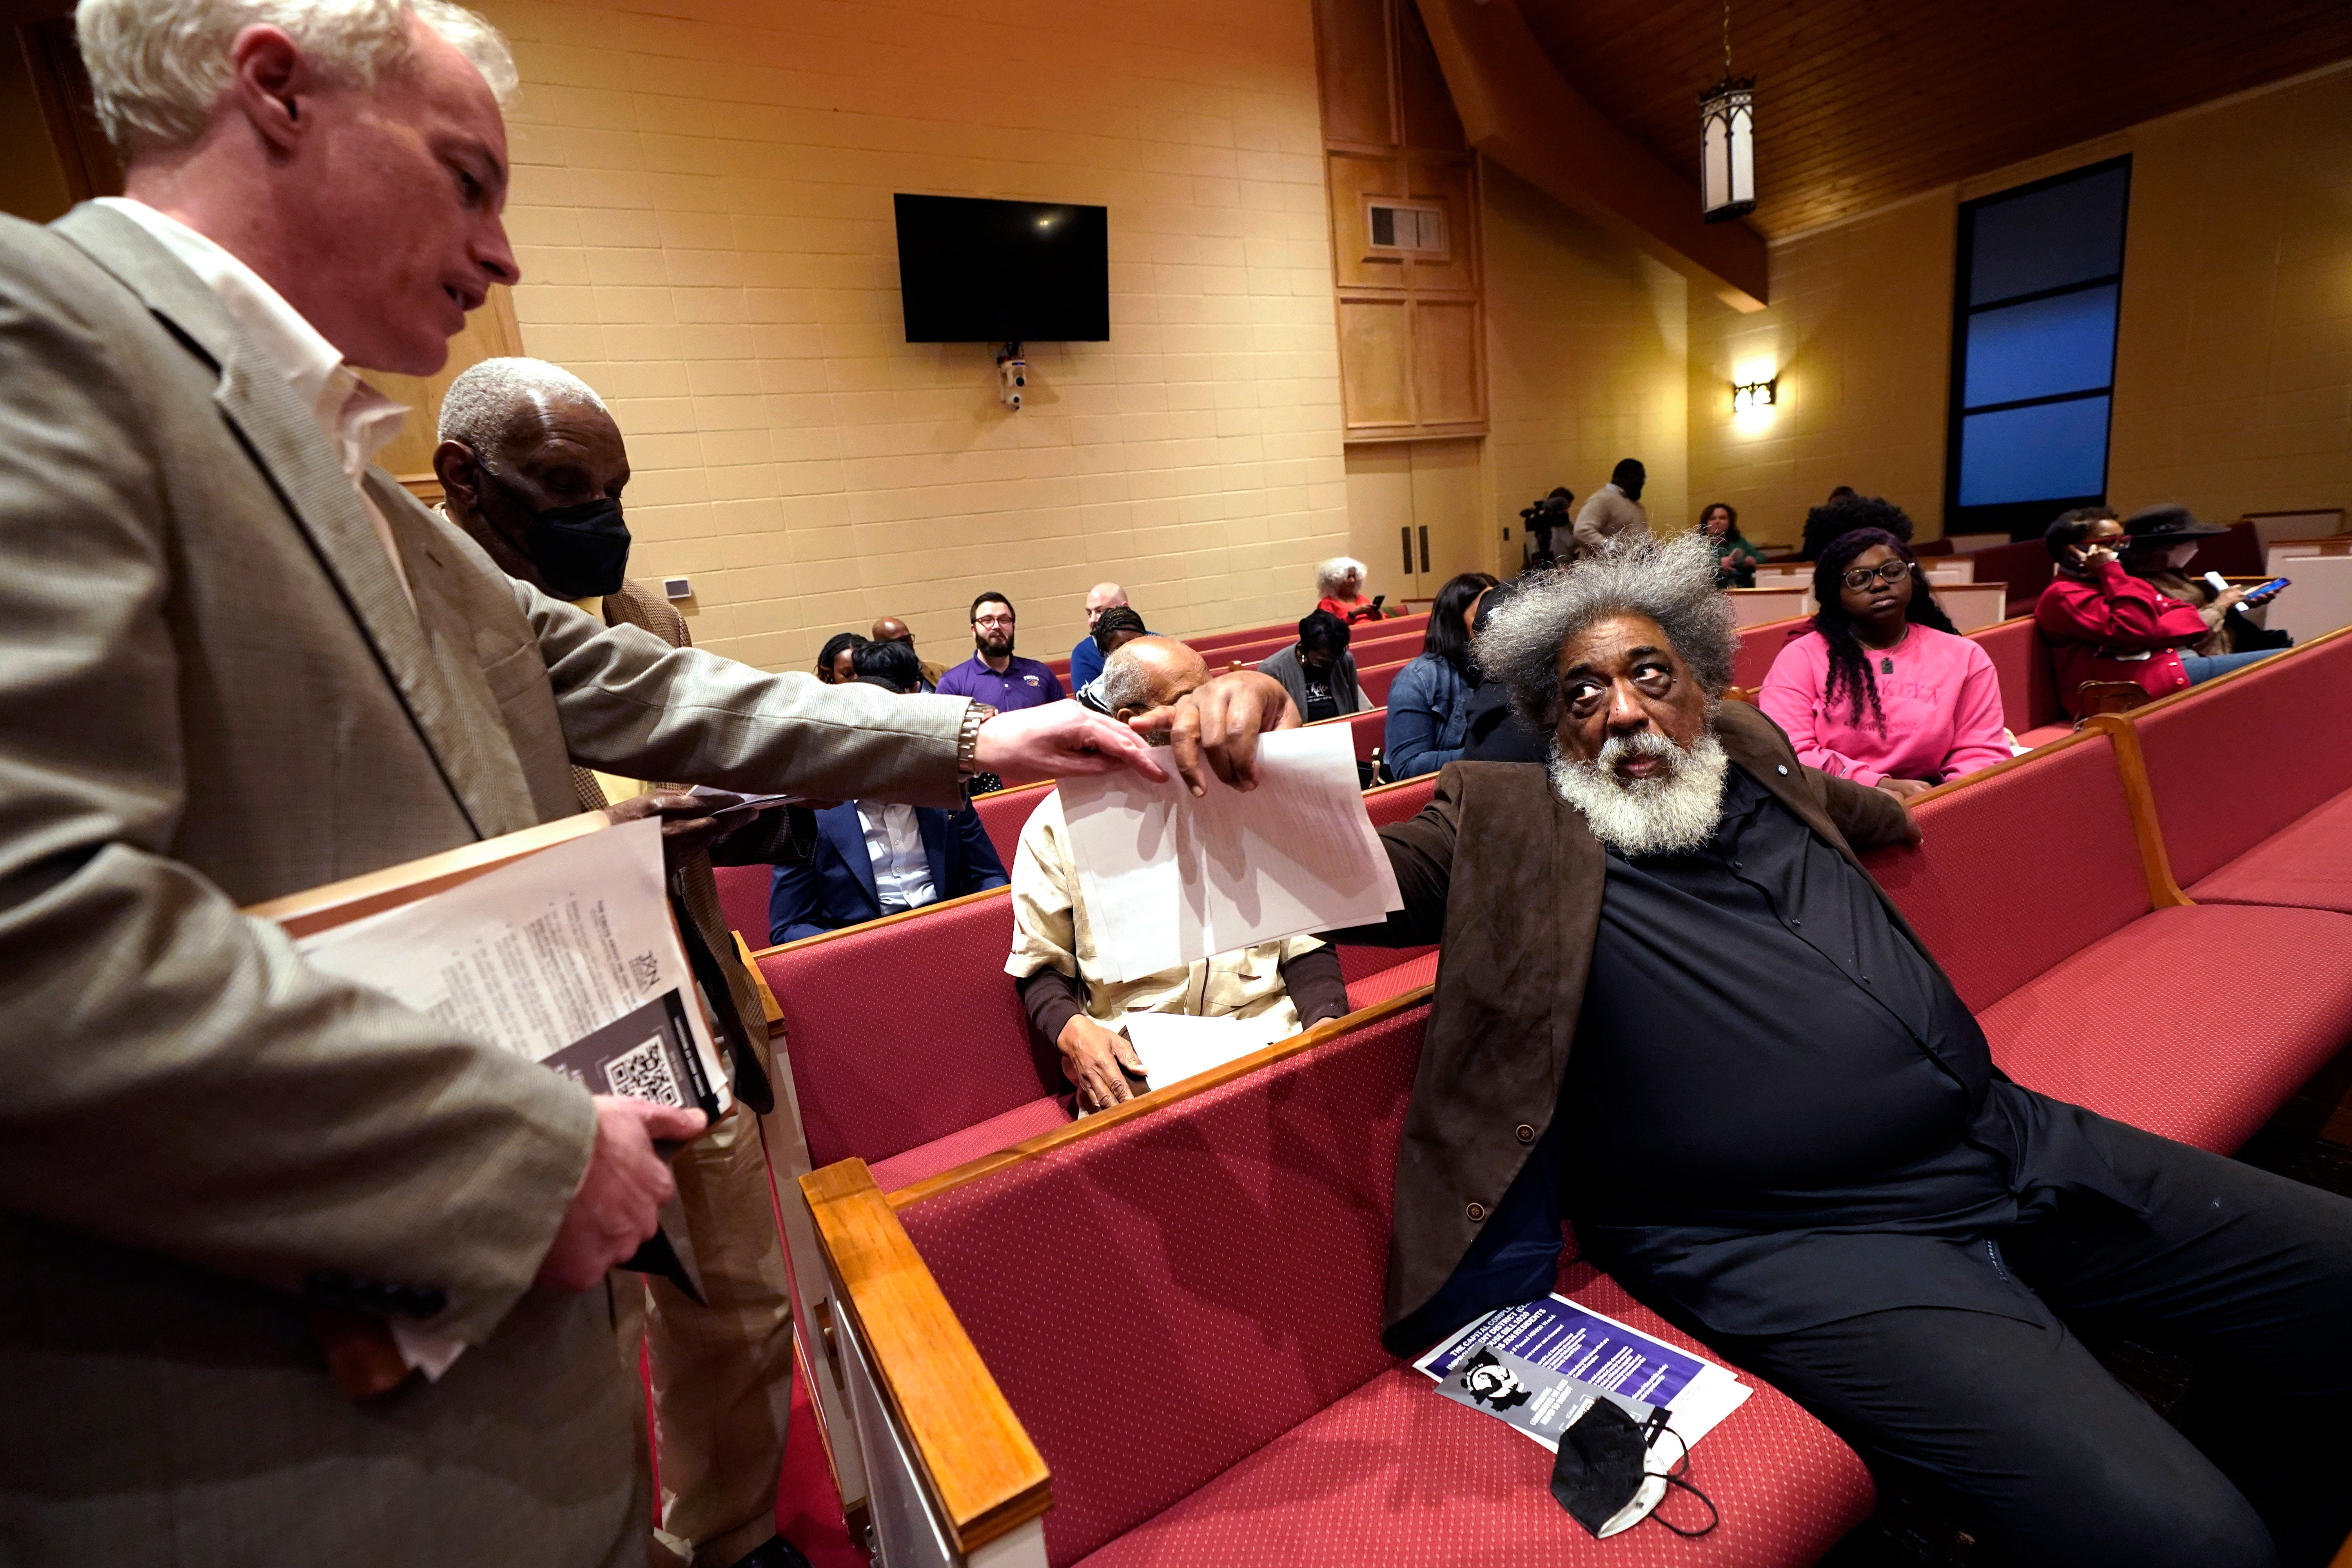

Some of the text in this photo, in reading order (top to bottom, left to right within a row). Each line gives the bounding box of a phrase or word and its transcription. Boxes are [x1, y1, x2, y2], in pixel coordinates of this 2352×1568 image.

[1449, 1306, 1514, 1356] THE CAPITAL COMPLE
[1486, 1333, 1504, 1347] USE
[1501, 1324, 1517, 1335] BILL
[1514, 1312, 1530, 1325] 1020
[1489, 1311, 1517, 1334] DISTRICT
[1503, 1308, 1546, 1345] JXN RESIDENTS
[1515, 1336, 1530, 1349] Passed
[1528, 1325, 1544, 1338] HB1020
[1541, 1314, 1557, 1326] Would:
